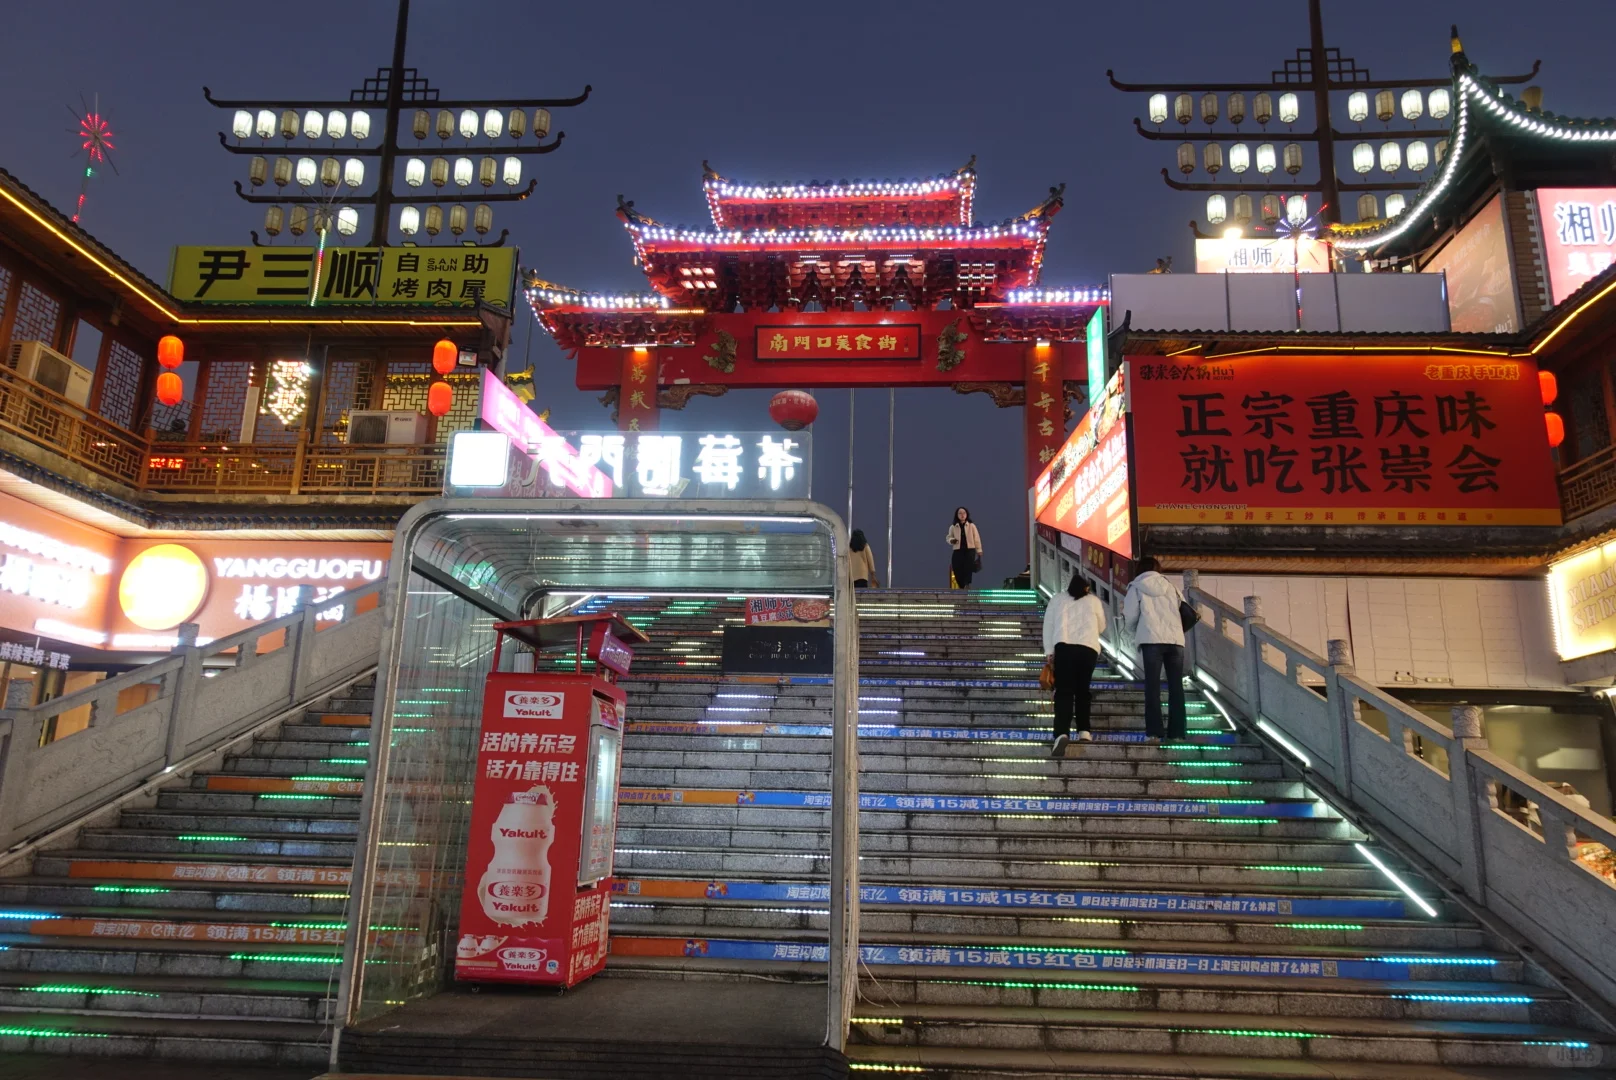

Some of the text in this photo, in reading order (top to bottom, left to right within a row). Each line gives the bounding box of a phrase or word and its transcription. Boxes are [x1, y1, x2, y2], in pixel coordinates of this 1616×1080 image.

[194, 249, 385, 298] 尹三顺
[391, 278, 487, 299] 烤肉屋
[769, 333, 899, 353] 南門口美食街
[1424, 364, 1519, 381] 老重庆 手工料
[1176, 390, 1498, 441] 正宗重庆味
[1179, 443, 1503, 496] 就吃张崇会
[213, 557, 383, 580] YANGGUOFU
[515, 708, 552, 717] Yakult
[480, 732, 577, 755] 活的养乐多
[899, 730, 1024, 740] 领满15减15红包
[486, 759, 580, 783] 活力靠得住
[896, 797, 1044, 810] 领满15减15红包
[499, 828, 548, 839] Yakult
[173, 865, 225, 878] 淘宝闪购
[492, 901, 540, 913] Yakult
[898, 889, 1078, 907] 领满15减15红包
[1082, 895, 1177, 909] 即日起手机淘宝扫一扫
[91, 922, 142, 936] 淘宝闪购
[206, 926, 344, 943] 领满15减15红
[504, 962, 538, 971] Yakult
[773, 944, 826, 960] 淘宝闪购
[898, 947, 1098, 968] 领满15减15红包
[1102, 956, 1209, 971] 即日起手机淘宝扫一扫
[1210, 960, 1320, 975] 上淘宝闪购点饿了么外卖
